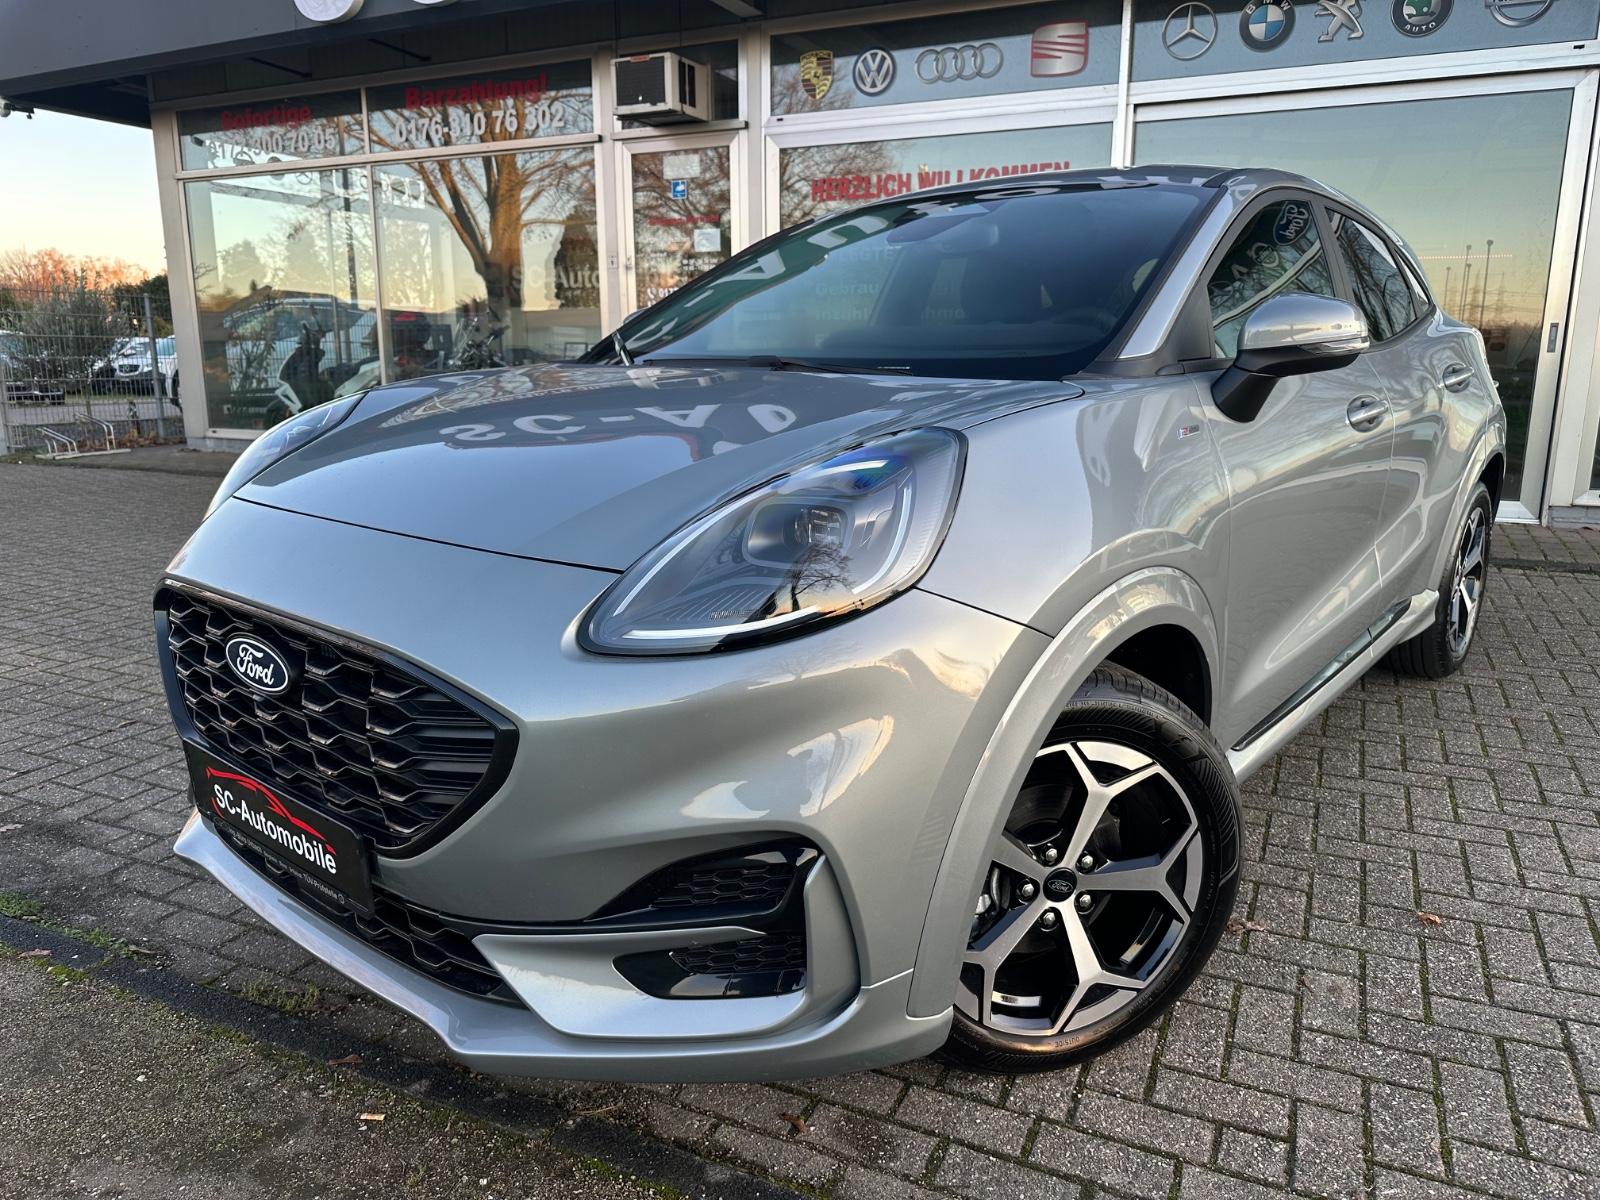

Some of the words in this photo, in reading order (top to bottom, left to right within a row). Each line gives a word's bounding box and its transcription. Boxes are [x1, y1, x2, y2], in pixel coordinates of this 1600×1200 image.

[1405, 22, 1436, 32] AUTO
[406, 72, 547, 110] Barzahlung!
[395, 111, 487, 142] 0176-310
[492, 109, 519, 132] 76
[525, 102, 566, 130] 302
[287, 130, 309, 153] 70
[313, 126, 336, 150] 05
[811, 172, 911, 202] HERZLICH
[236, 642, 275, 686] Ford
[213, 784, 337, 874] SC-Automobile
[1051, 881, 1070, 893] Ford
